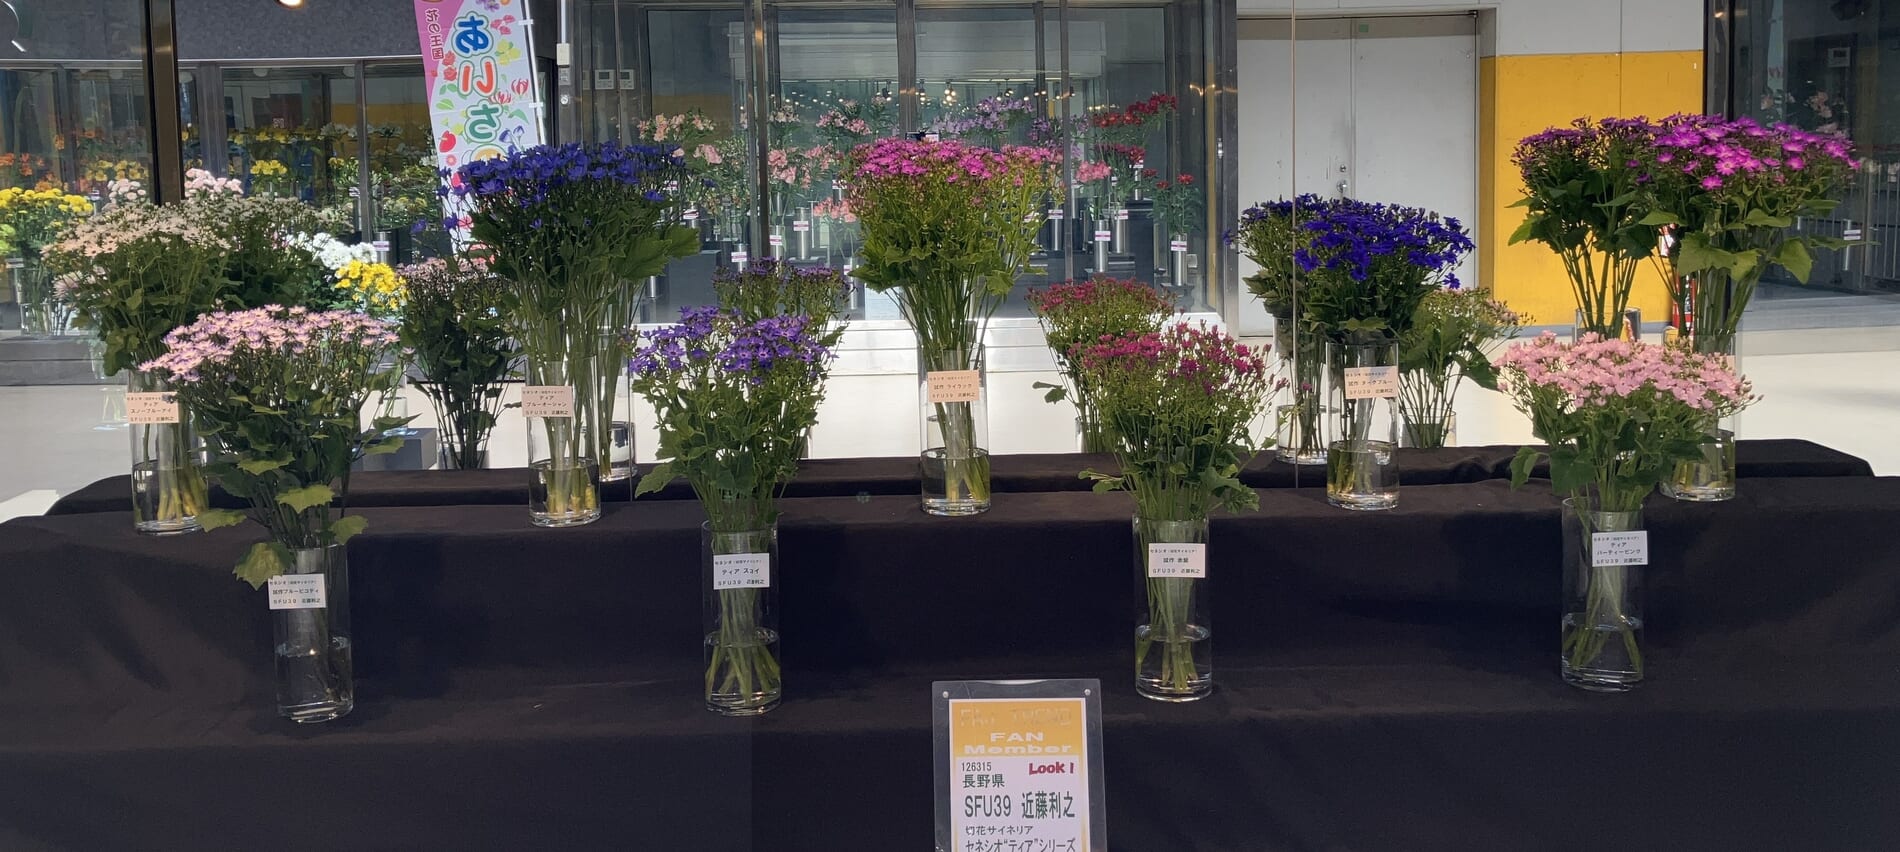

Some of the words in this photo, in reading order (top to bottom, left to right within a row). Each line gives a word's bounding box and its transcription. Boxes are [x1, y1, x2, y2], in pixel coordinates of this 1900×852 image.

[990, 731, 1044, 742] FAN
[964, 744, 1072, 755] Member
[961, 761, 992, 772] 126315
[962, 773, 1006, 789] 長野県
[964, 794, 1012, 818] SFU39
[1021, 791, 1076, 819] 近藤利之
[965, 825, 1034, 836] 切花サイネリア
